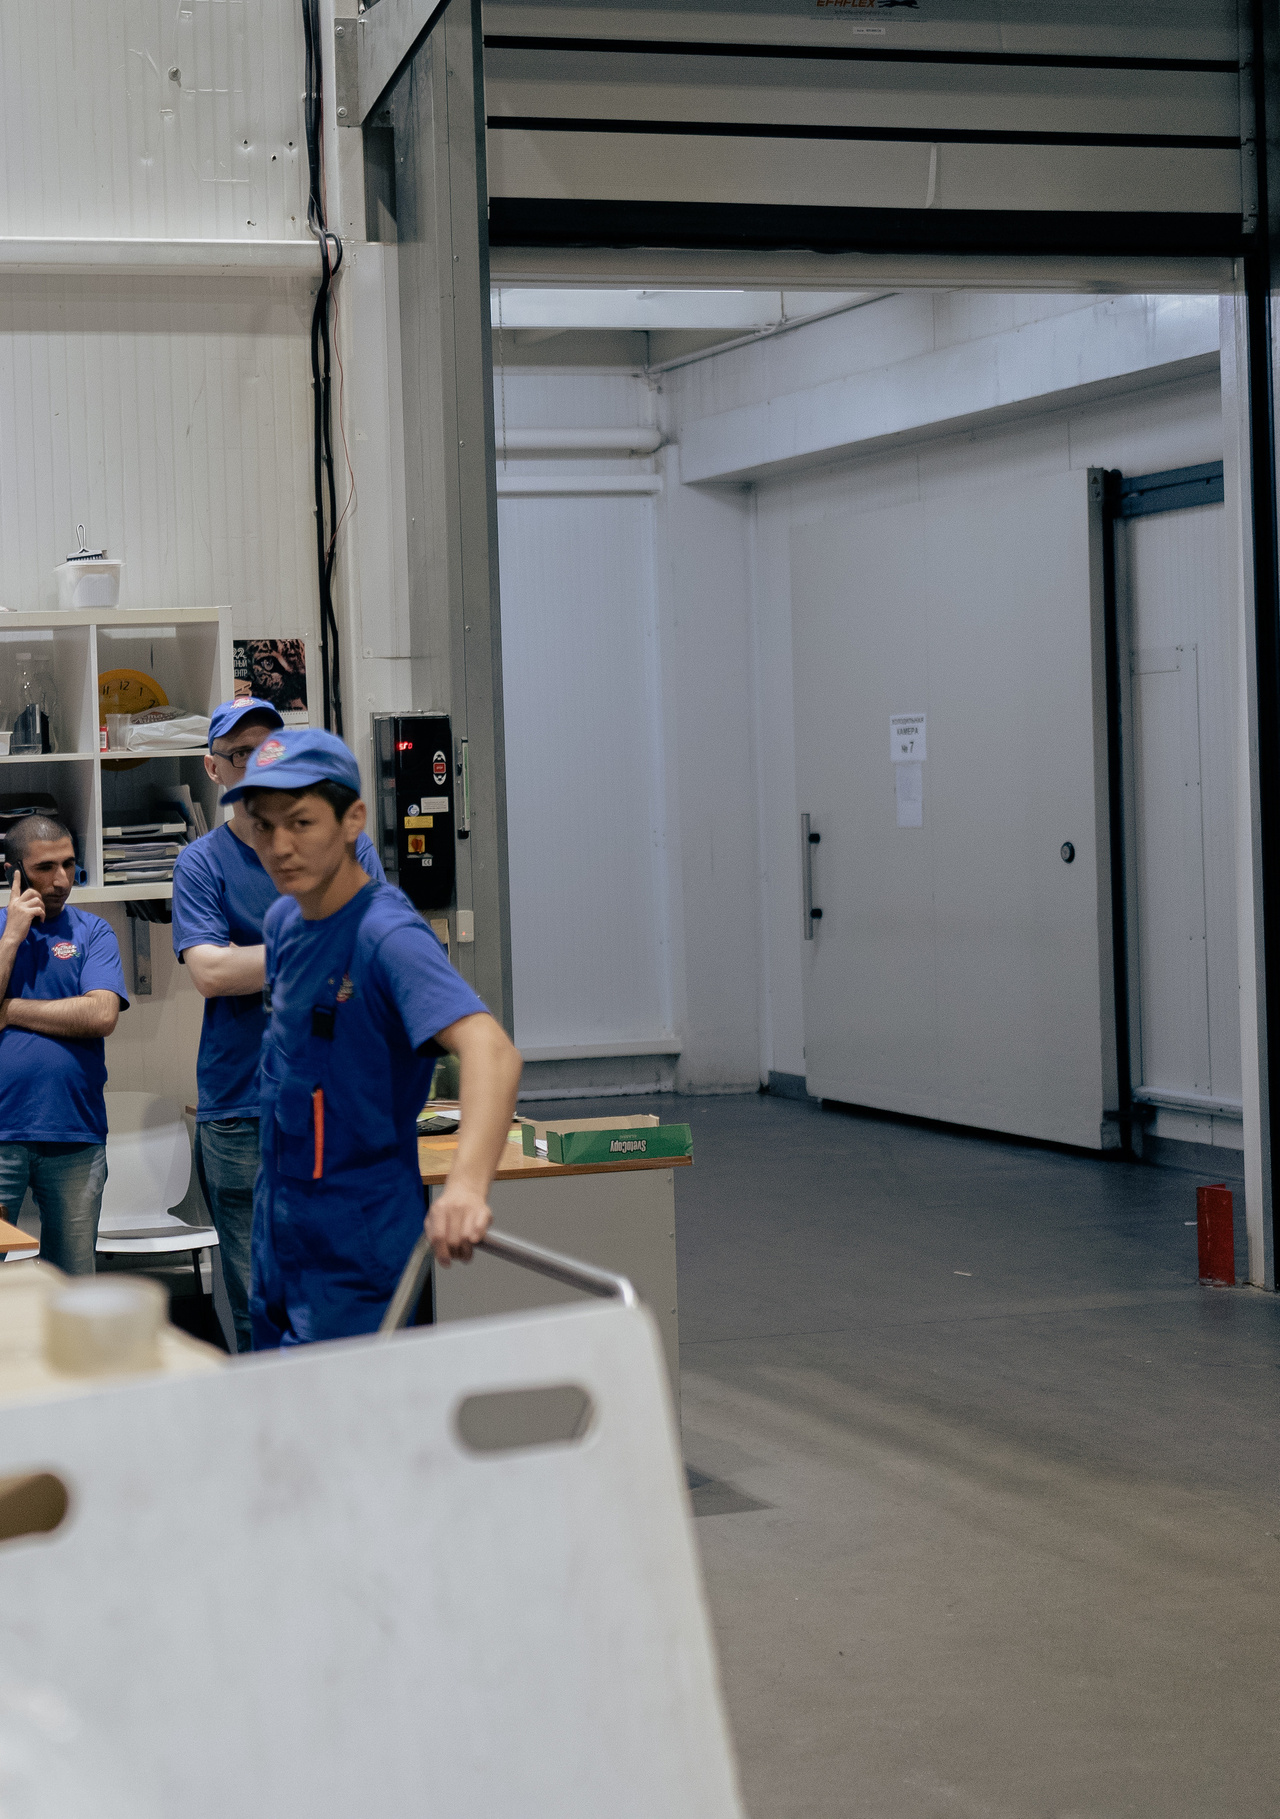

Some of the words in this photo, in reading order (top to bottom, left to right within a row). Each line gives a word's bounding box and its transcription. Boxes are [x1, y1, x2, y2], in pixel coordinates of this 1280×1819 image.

[102, 685, 110, 695] 11
[119, 681, 130, 691] 12
[909, 741, 914, 753] 7
[609, 1139, 647, 1154] SvetoCopy
